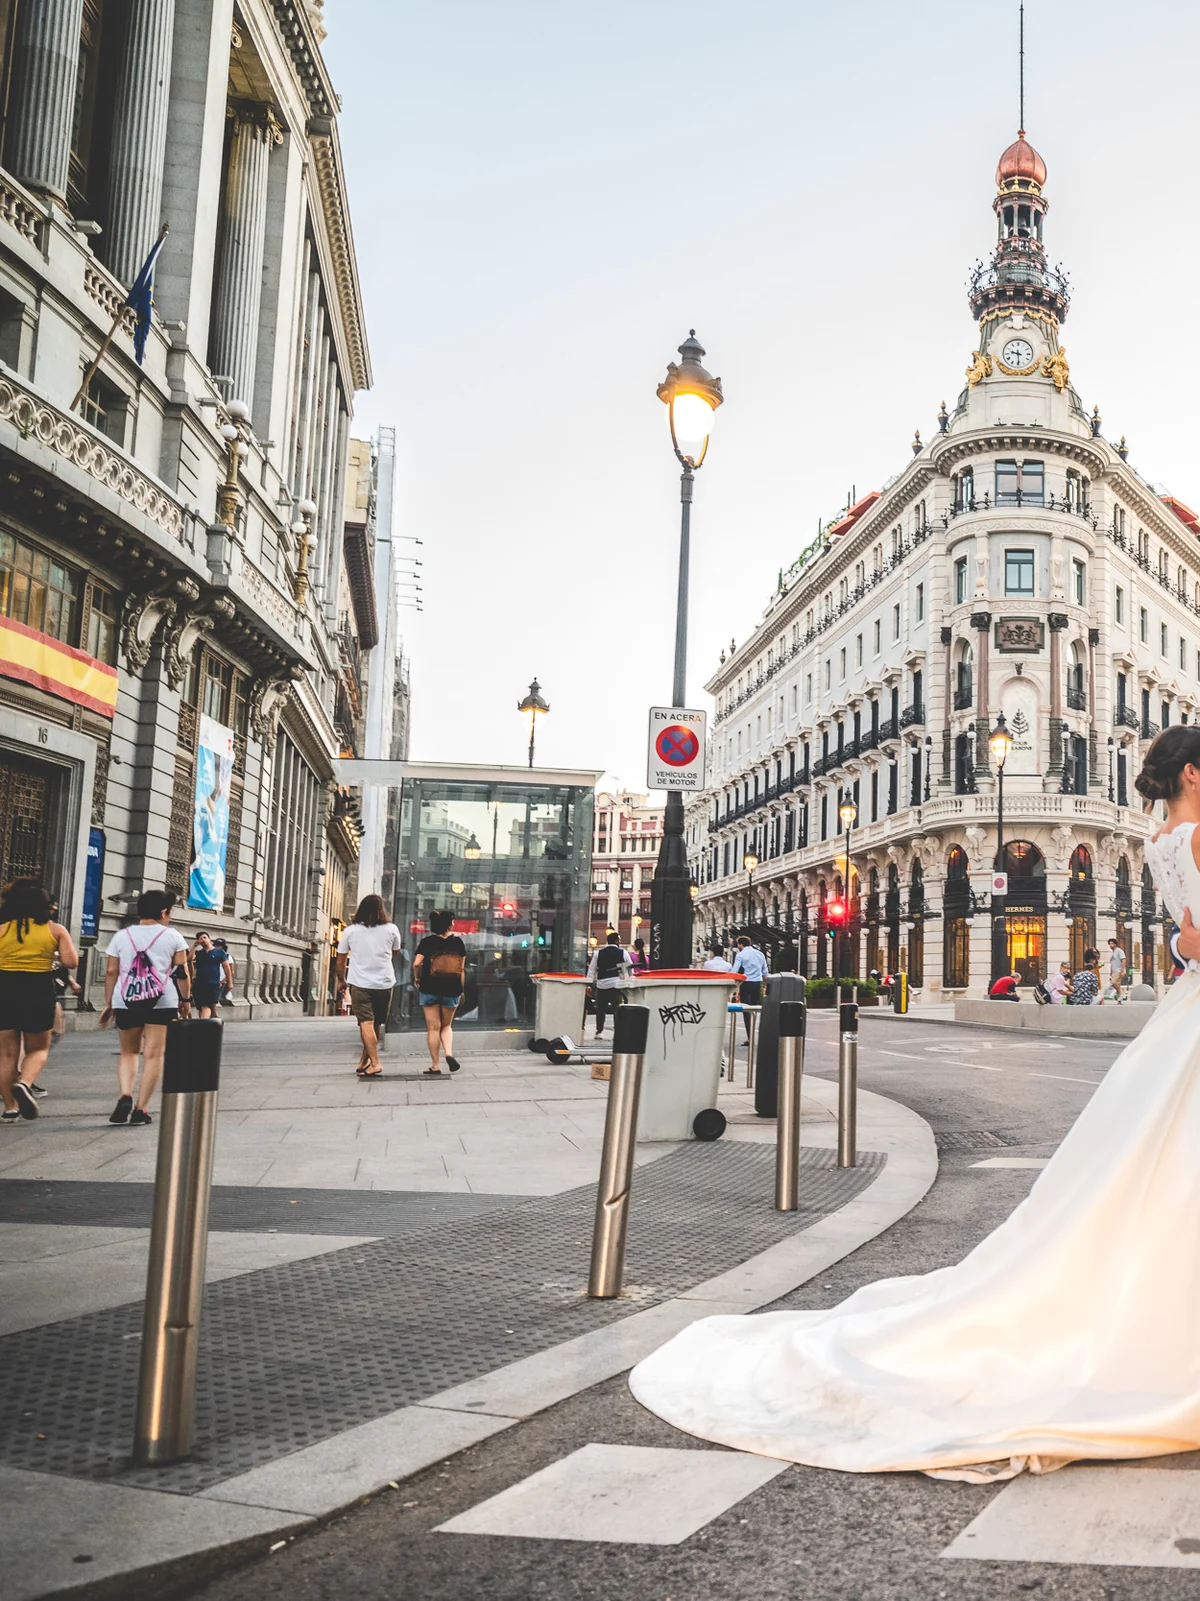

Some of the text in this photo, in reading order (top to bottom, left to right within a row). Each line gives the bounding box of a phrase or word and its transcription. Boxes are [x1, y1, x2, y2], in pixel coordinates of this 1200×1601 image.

[655, 712, 702, 723] EN ACERA
[37, 726, 48, 744] 16
[655, 771, 698, 779] VEHÍCULOS
[669, 778, 696, 786] MOTOR
[126, 981, 142, 998] DO
[145, 975, 155, 993] IT
